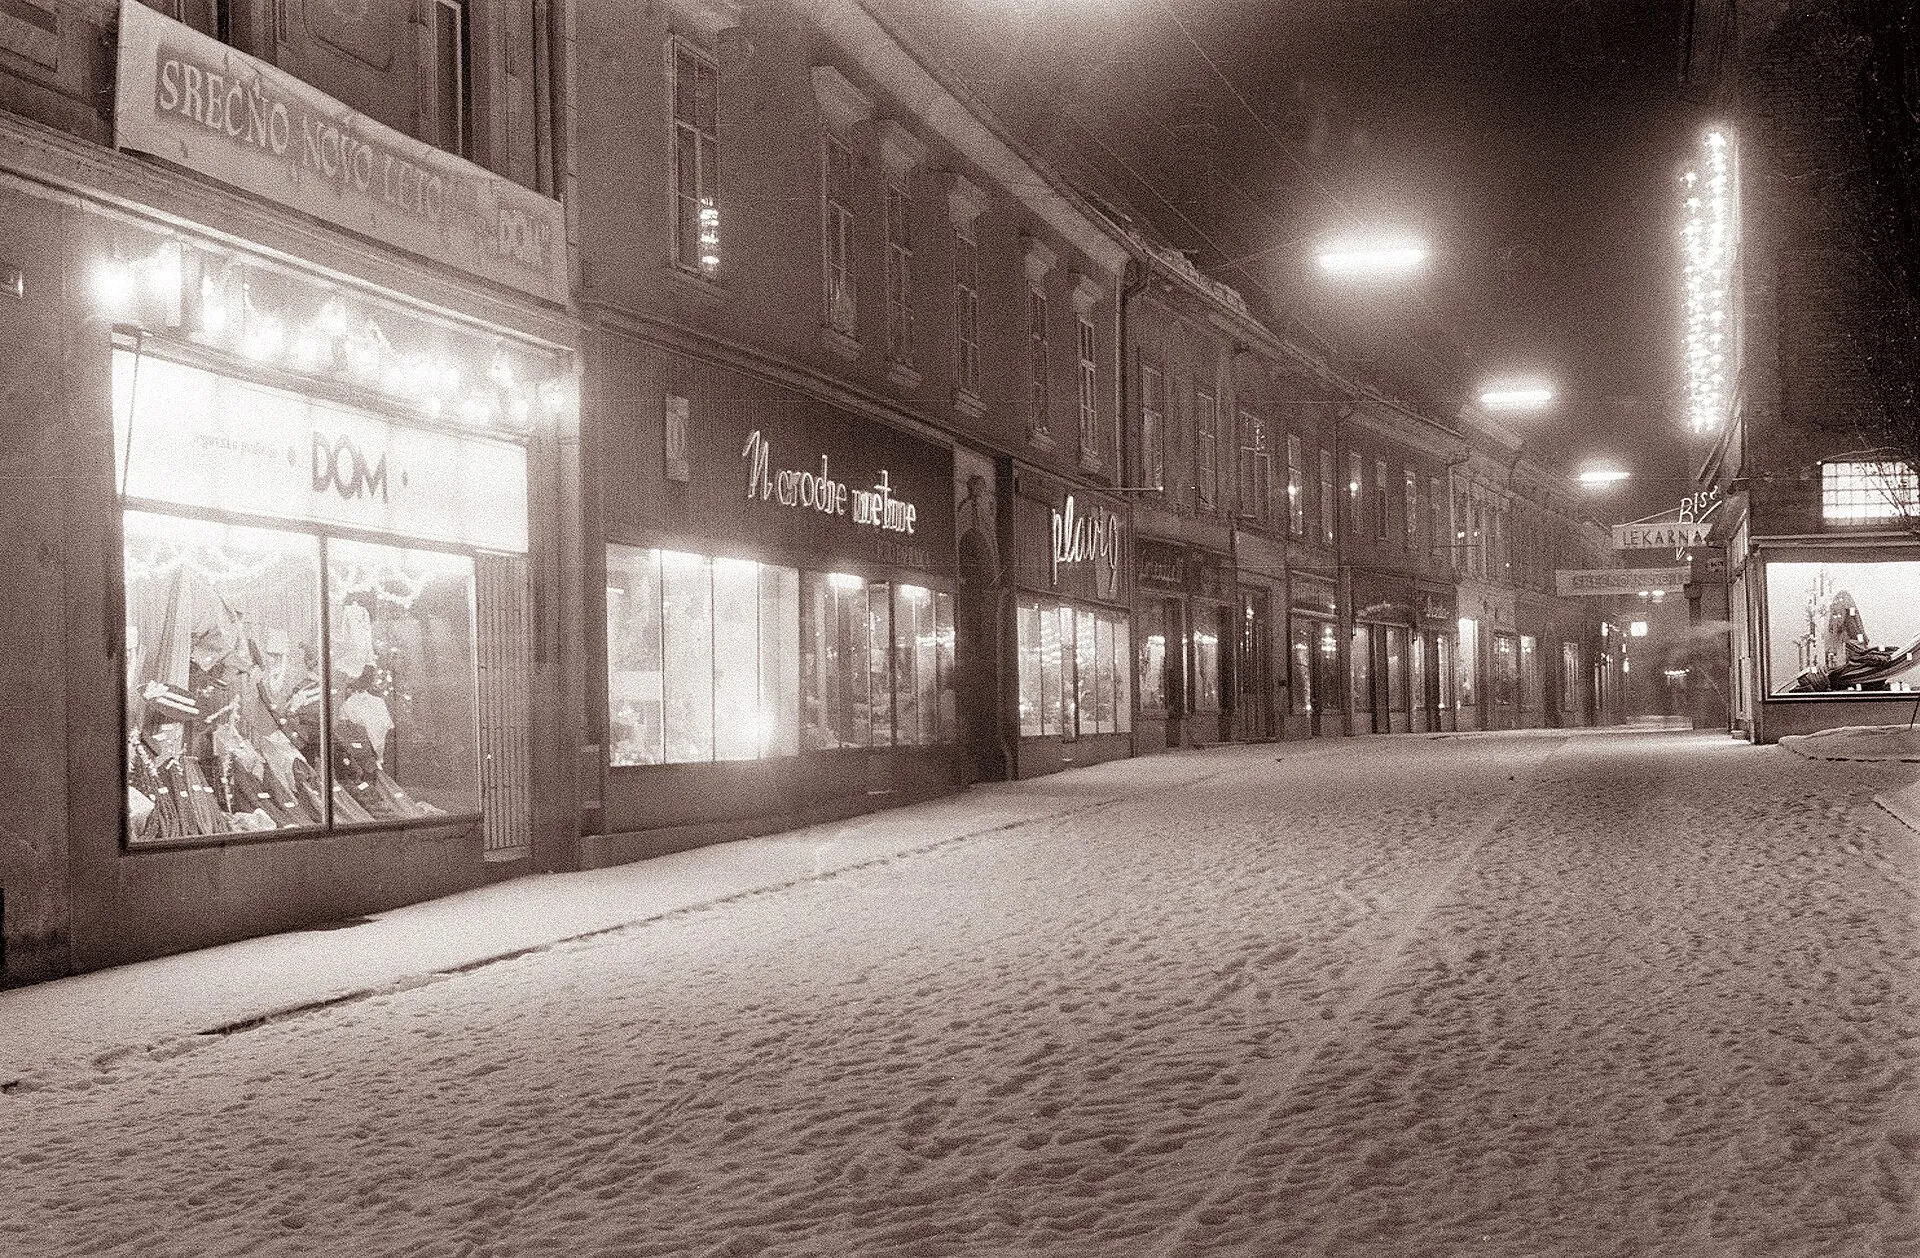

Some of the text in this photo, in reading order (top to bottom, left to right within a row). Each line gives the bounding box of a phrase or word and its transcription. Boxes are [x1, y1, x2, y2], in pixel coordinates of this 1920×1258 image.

[159, 59, 443, 222] SREČNO NOVO LETO
[311, 431, 388, 504] DOM
[742, 430, 847, 515] Narodne
[1622, 529, 1704, 547] LEKARNA
